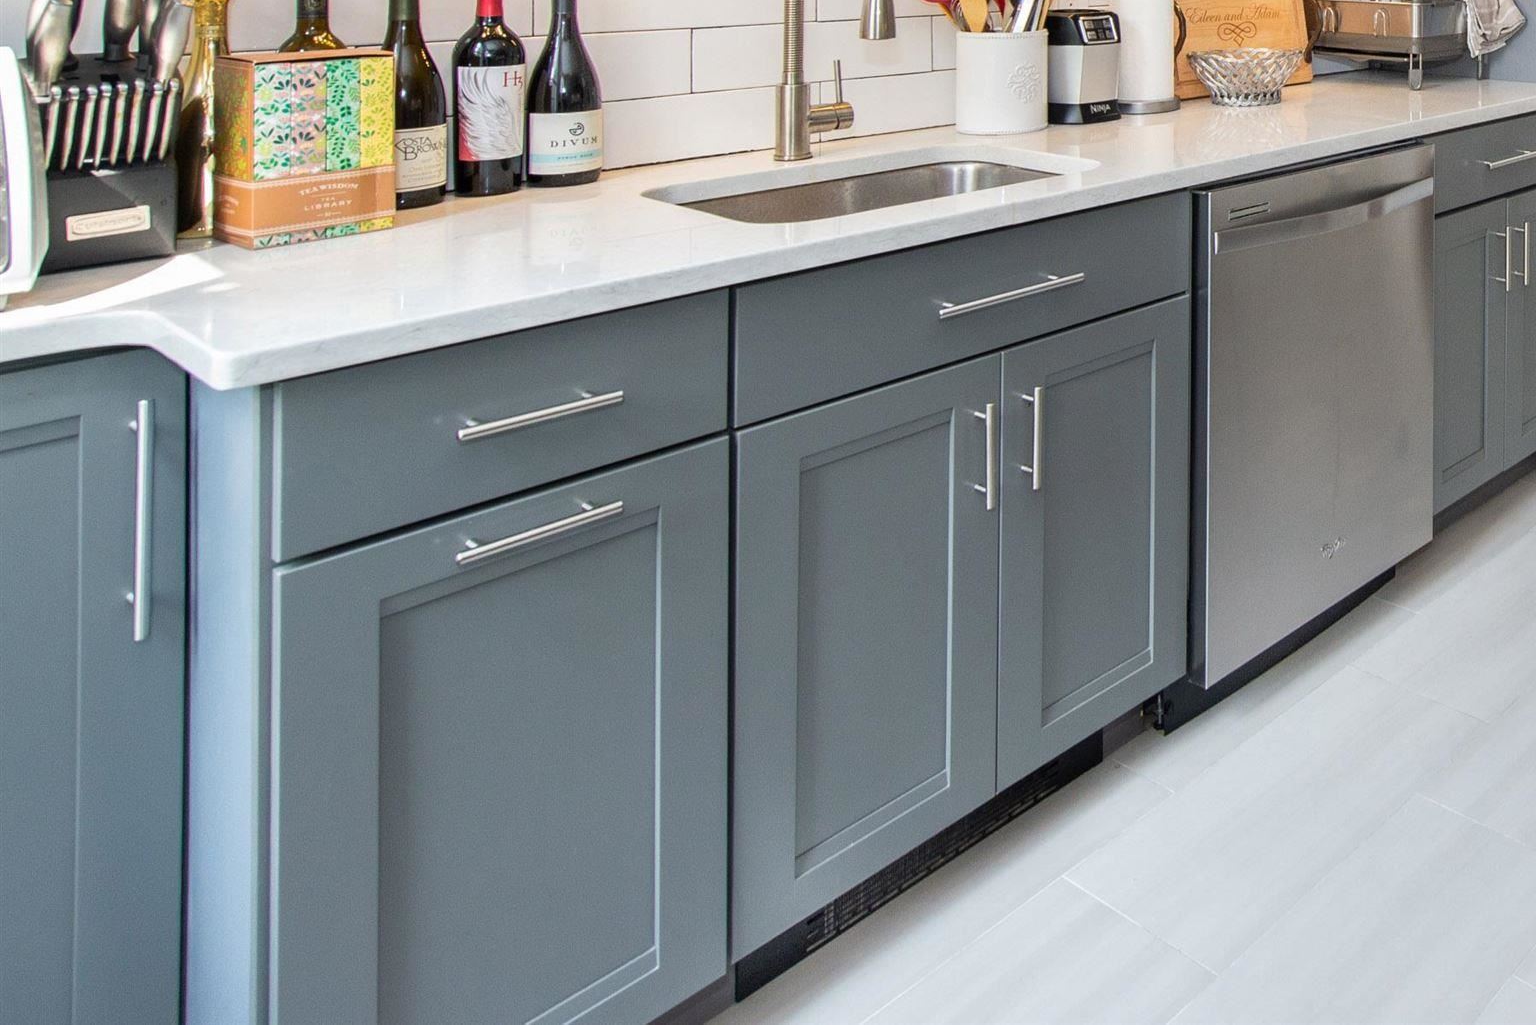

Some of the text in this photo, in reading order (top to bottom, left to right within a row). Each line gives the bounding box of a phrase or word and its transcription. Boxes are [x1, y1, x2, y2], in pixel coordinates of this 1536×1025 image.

[1186, 4, 1280, 24] Eileen and Adam
[1090, 104, 1111, 114] NINJA
[304, 199, 353, 211] LIBRARY
